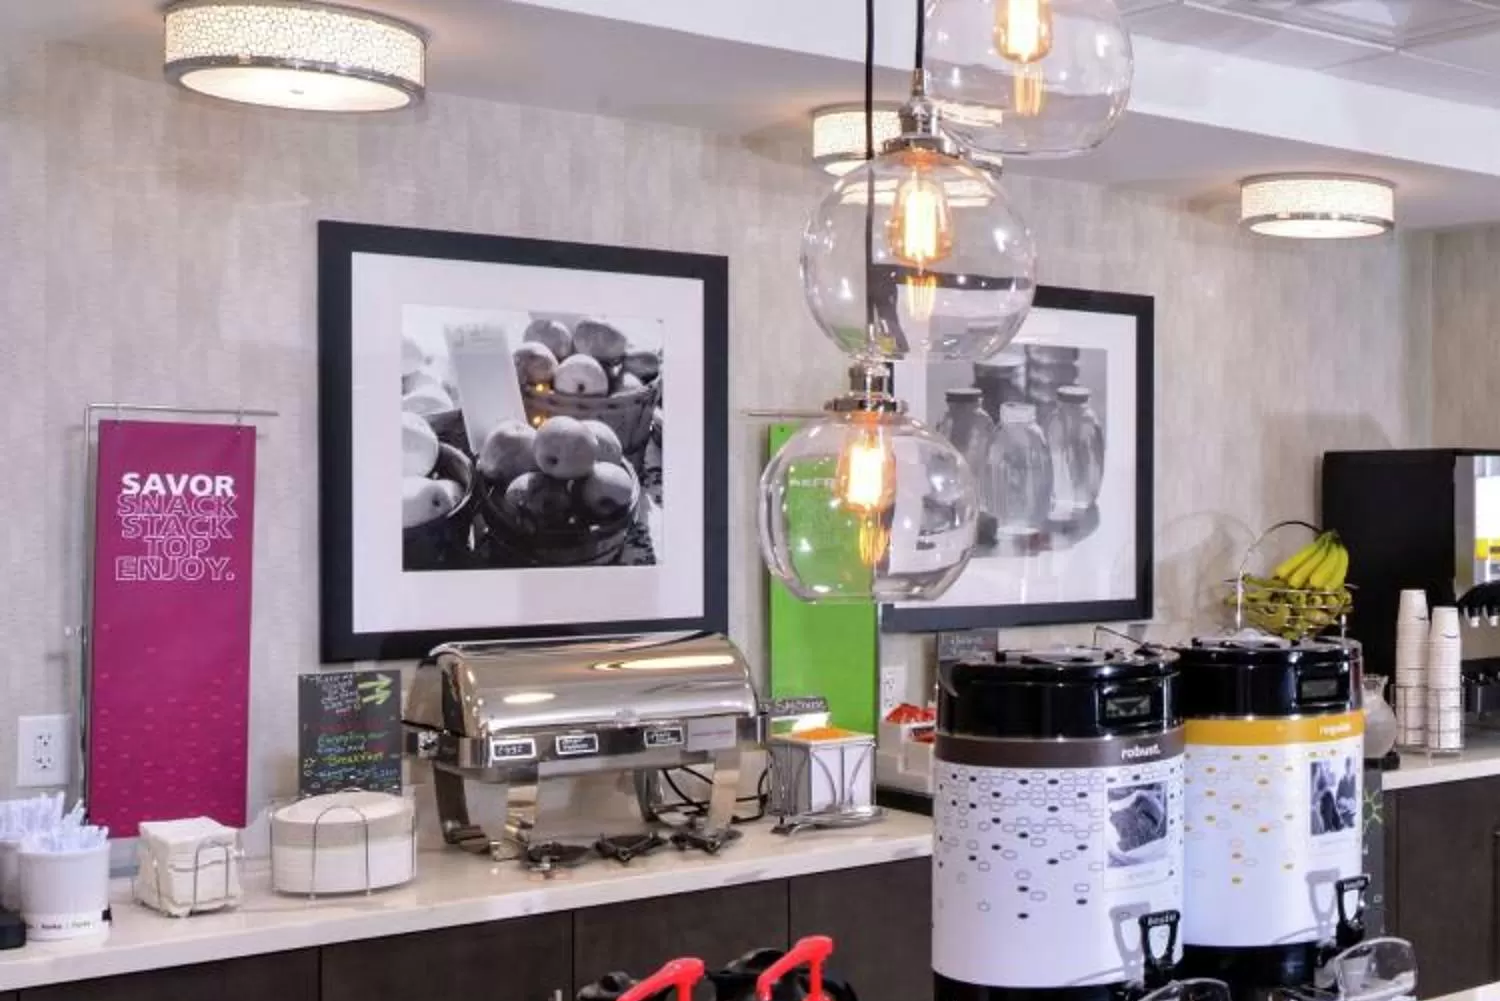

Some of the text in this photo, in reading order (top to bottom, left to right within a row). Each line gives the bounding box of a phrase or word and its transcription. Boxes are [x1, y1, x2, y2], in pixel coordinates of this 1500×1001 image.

[121, 472, 235, 497] SAVOR
[117, 494, 238, 518] SNACK
[121, 515, 233, 538] STACK
[143, 536, 211, 558] TOP
[115, 556, 235, 580] ENJOY.
